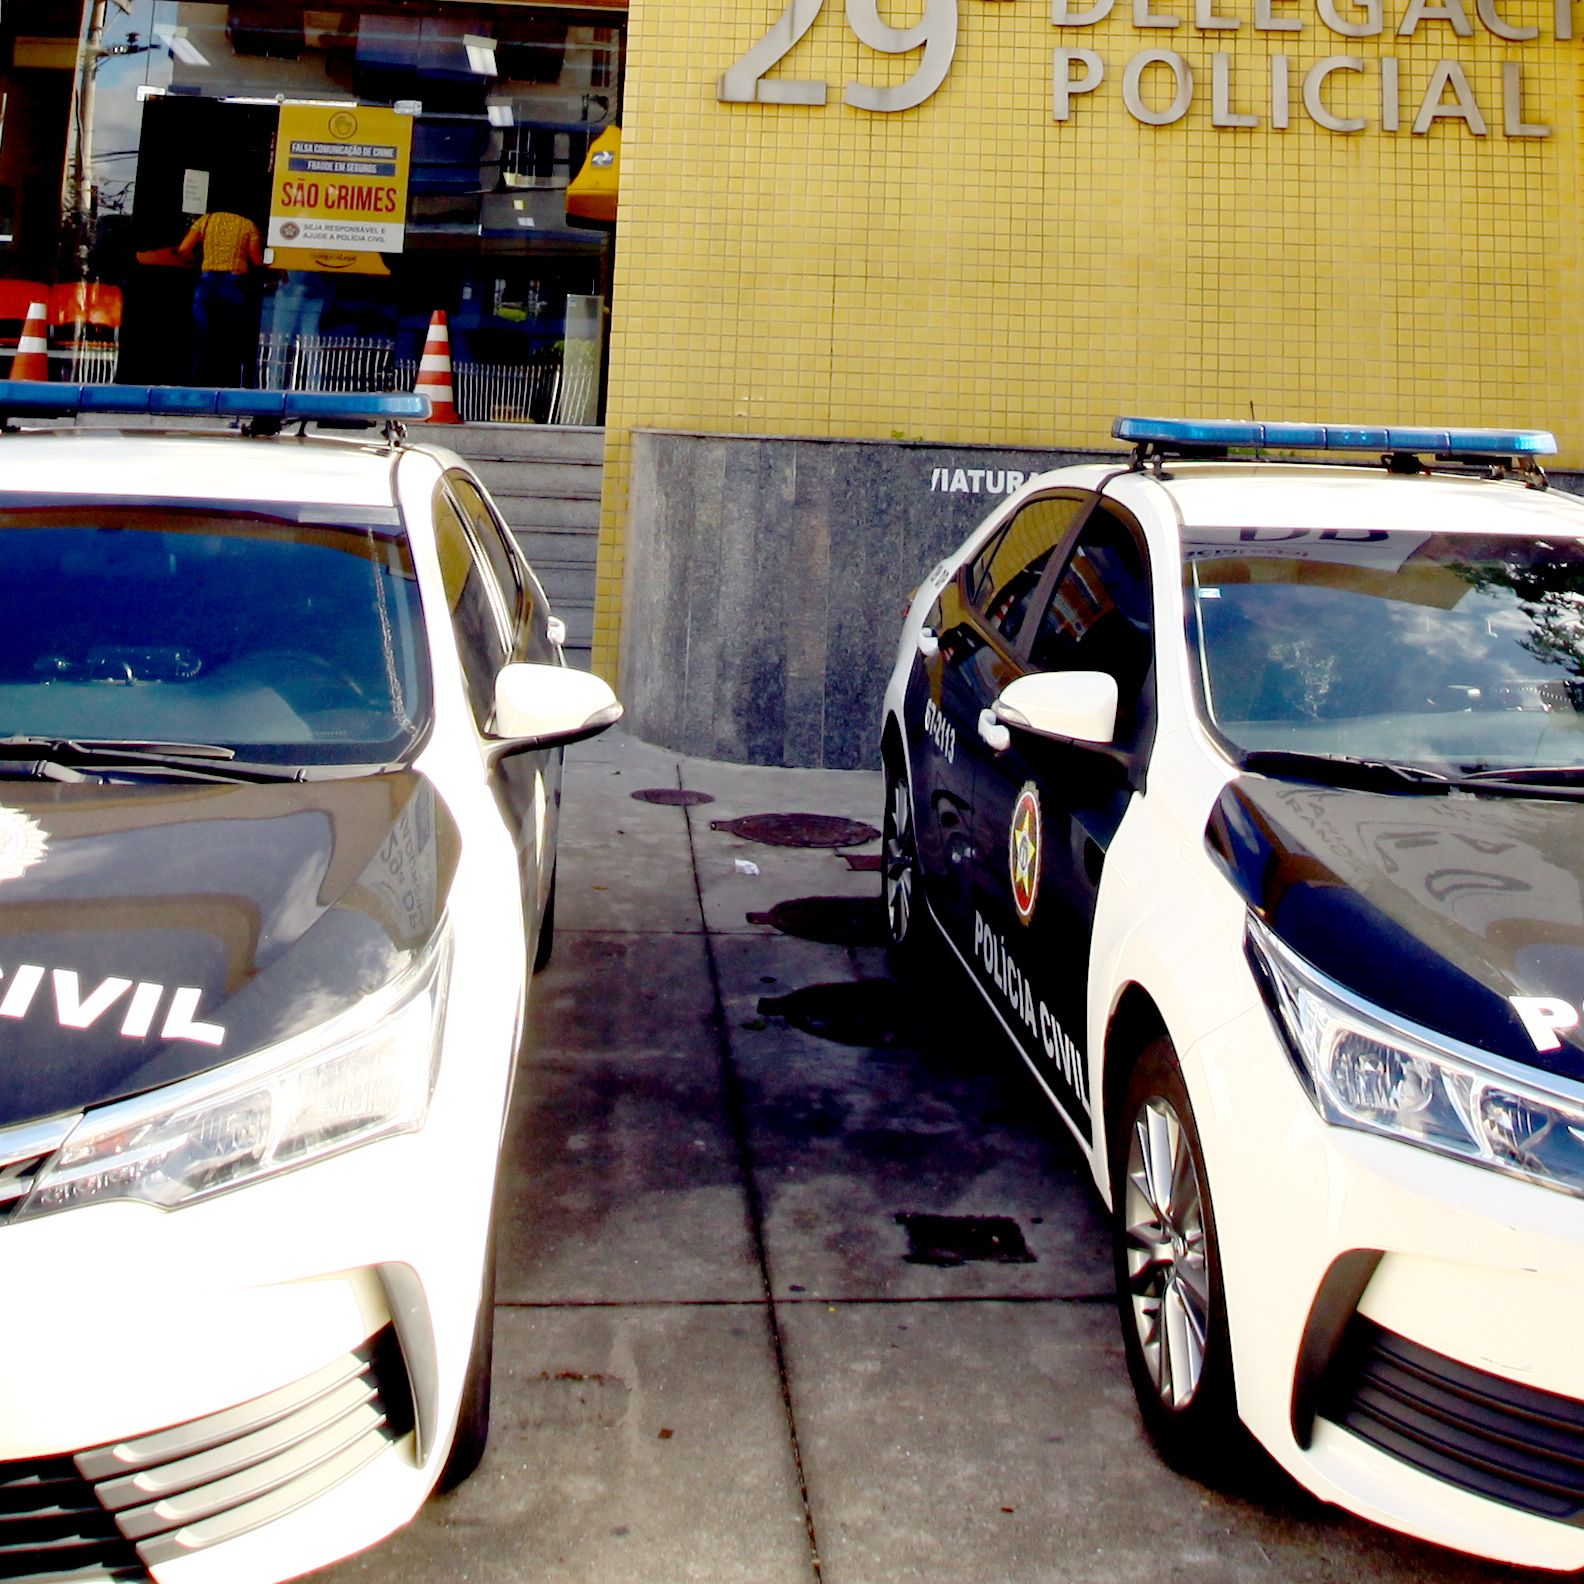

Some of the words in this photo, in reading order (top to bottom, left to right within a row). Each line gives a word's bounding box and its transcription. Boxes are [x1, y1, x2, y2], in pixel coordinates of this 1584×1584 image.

[1052, 47, 1552, 138] POLICIAL
[281, 178, 319, 209] SÃO
[324, 184, 398, 213] CRIMES
[973, 910, 1039, 1039] POLÍCIA
[1038, 1000, 1092, 1110] CIVIL
